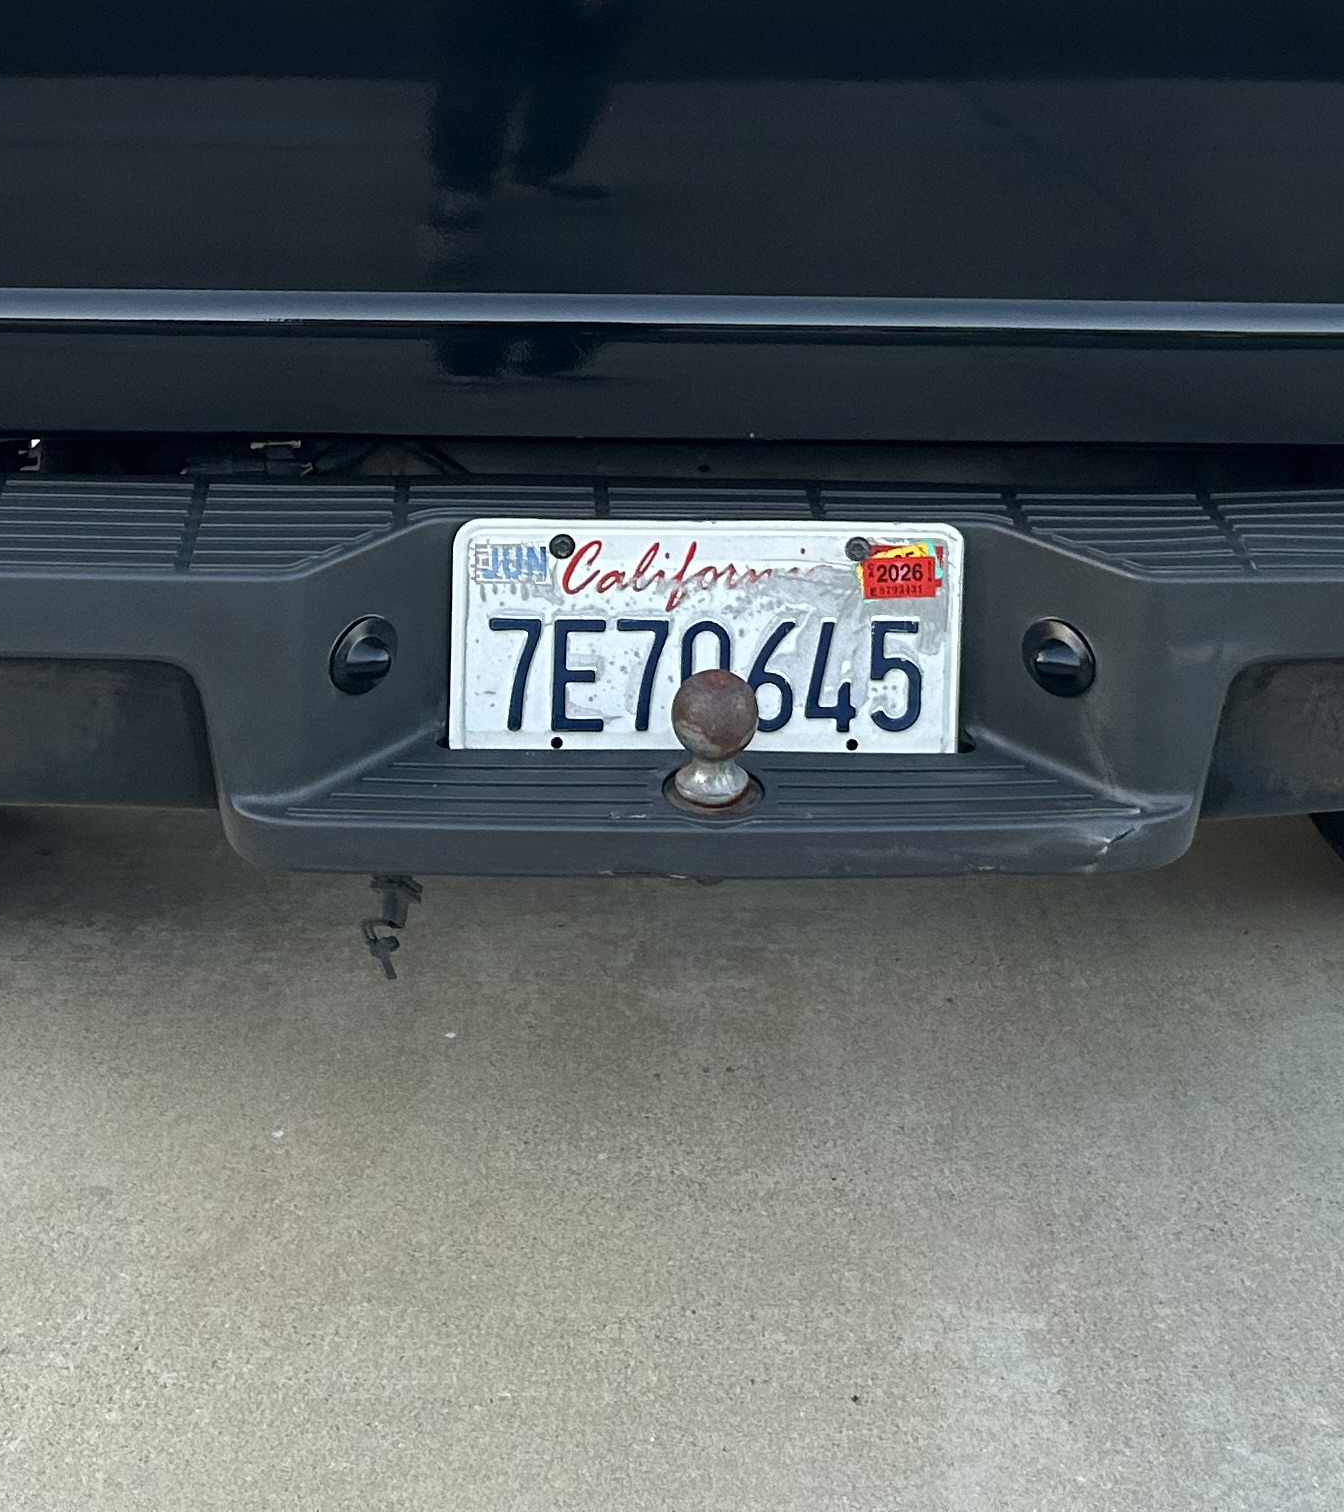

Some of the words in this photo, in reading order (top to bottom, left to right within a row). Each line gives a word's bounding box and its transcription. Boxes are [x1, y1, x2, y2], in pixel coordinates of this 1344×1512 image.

[482, 545, 547, 580] JUN
[562, 540, 834, 612] Californ
[876, 563, 923, 583] 2026
[489, 618, 923, 733] 7E70645
